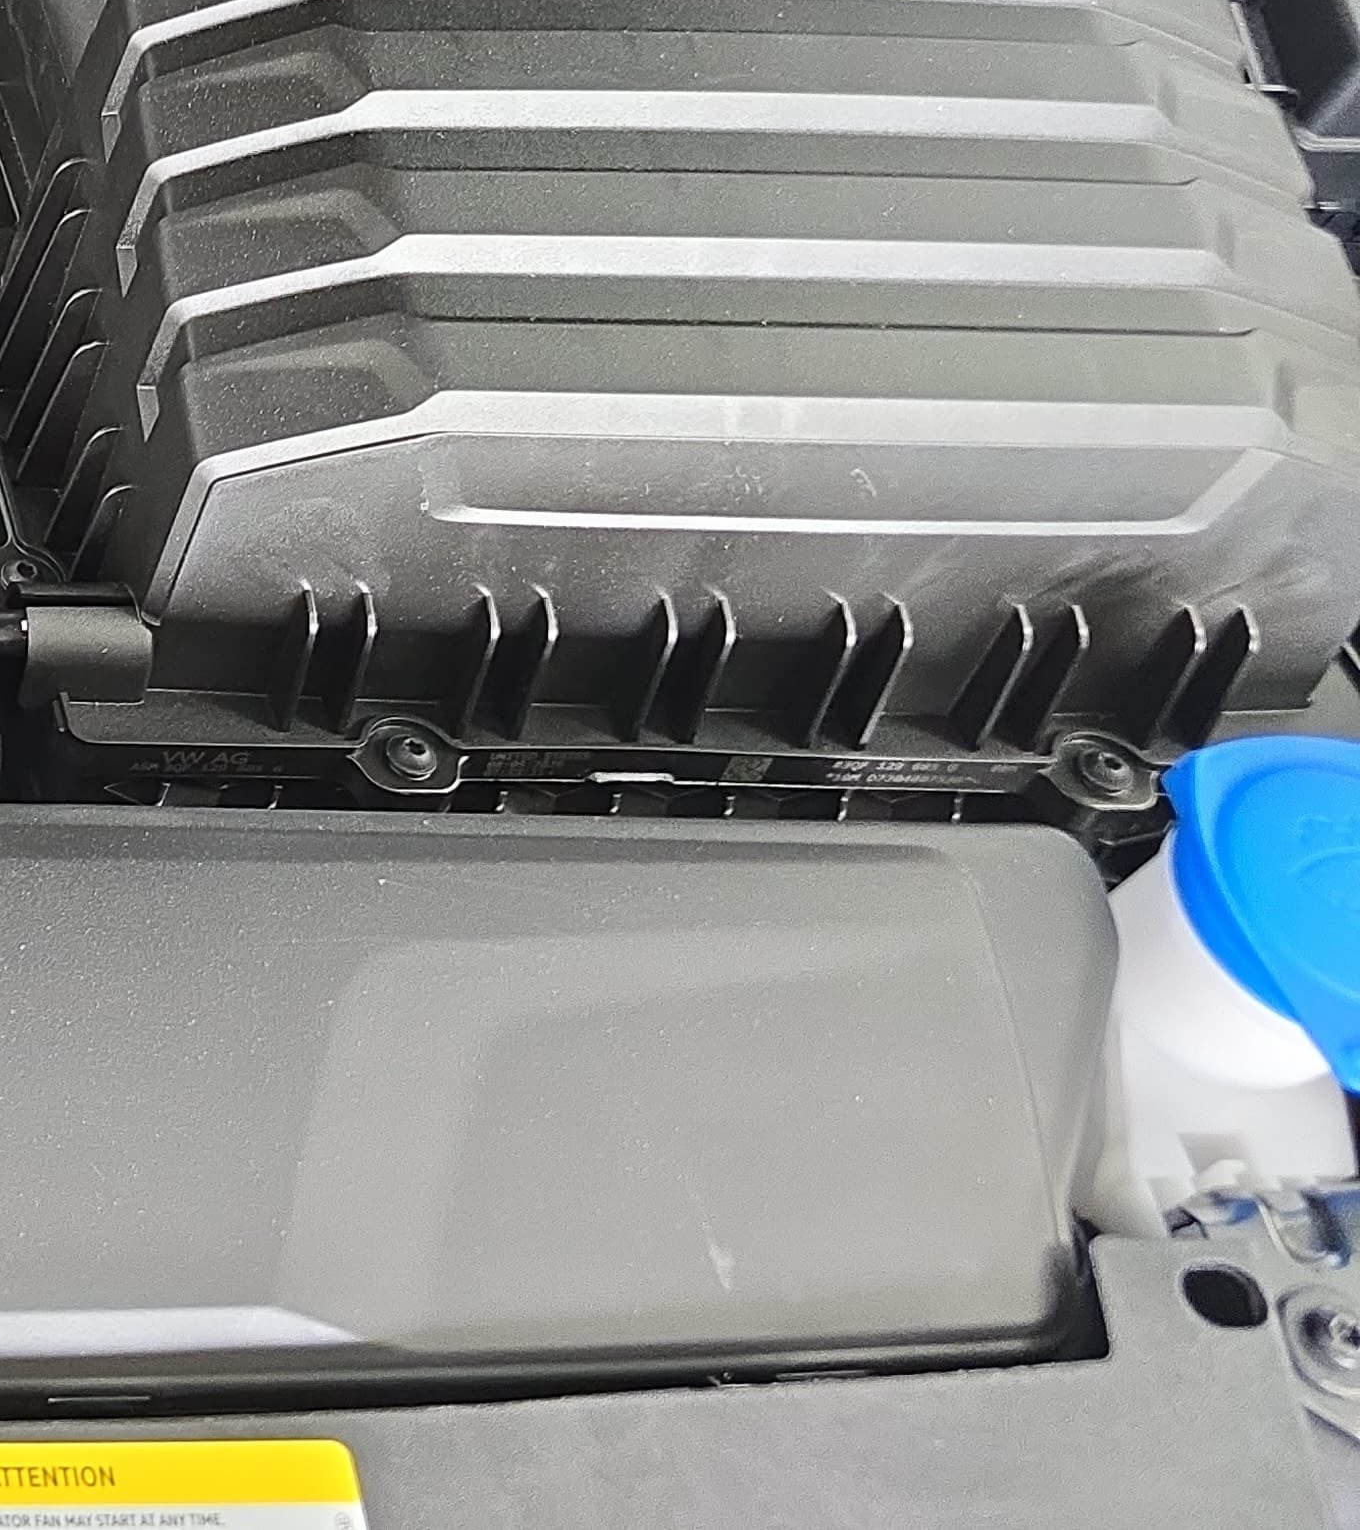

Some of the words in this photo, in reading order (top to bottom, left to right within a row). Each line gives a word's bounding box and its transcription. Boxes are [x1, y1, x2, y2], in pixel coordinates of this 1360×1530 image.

[34, 1513, 61, 1528] FAN
[64, 1513, 92, 1527] MAY
[96, 1513, 137, 1527] START
